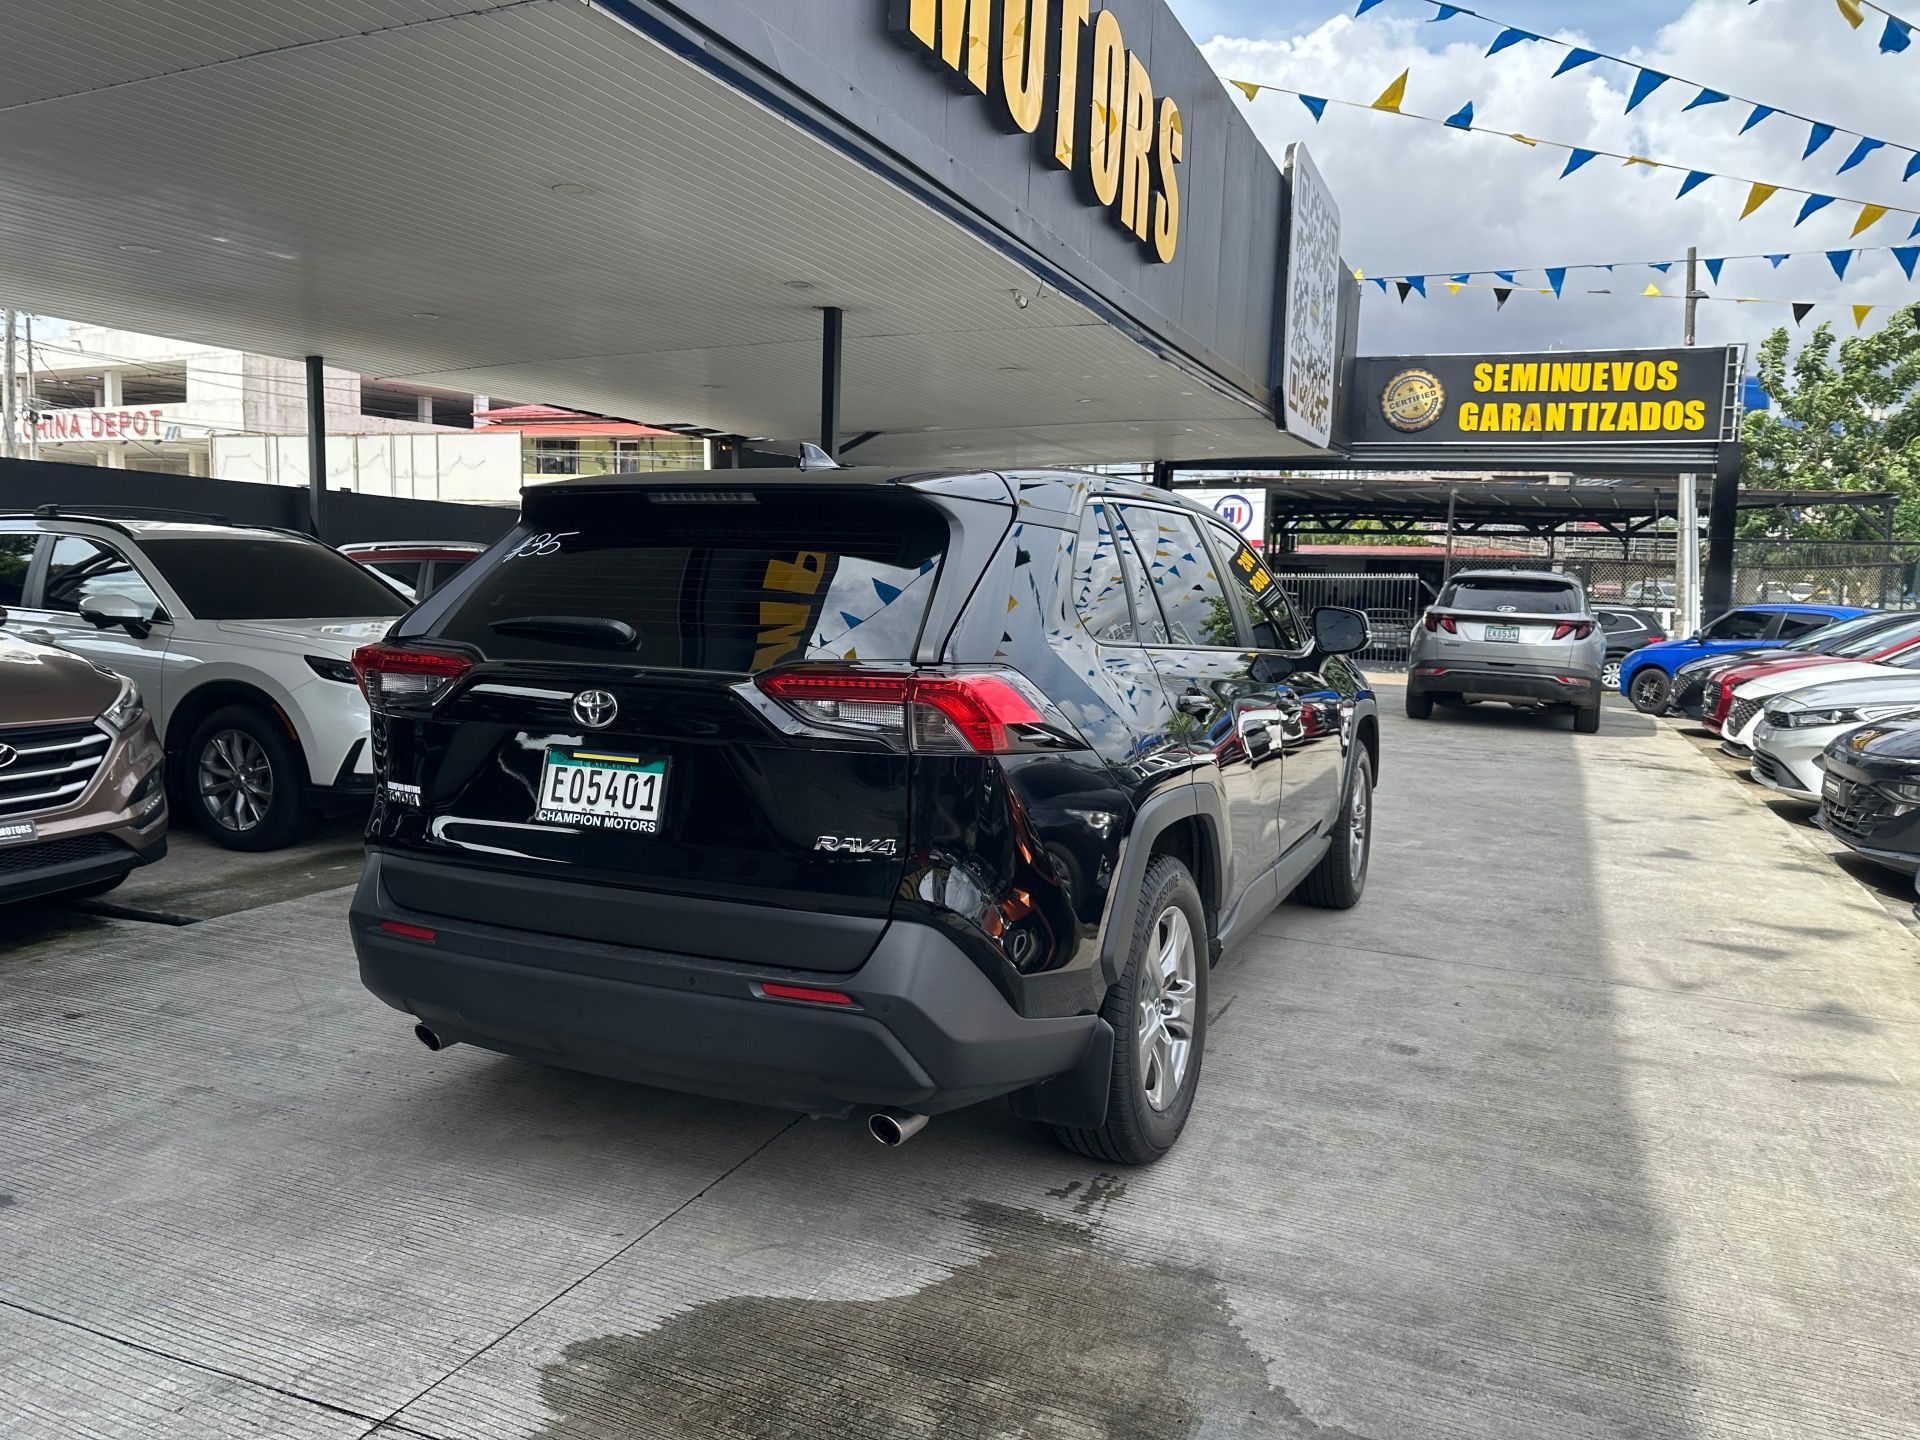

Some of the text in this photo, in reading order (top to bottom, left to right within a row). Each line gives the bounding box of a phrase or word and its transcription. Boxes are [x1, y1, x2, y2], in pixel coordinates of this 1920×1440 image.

[1473, 360, 1679, 393] SEMINUEVOS
[1389, 390, 1437, 410] CERTIFIED
[91, 409, 163, 438] DEPOT
[1458, 400, 1706, 432] GARANTIZADOS
[550, 766, 656, 812] E05401
[538, 810, 601, 827] CHAMPION
[604, 818, 656, 833] MOTORS
[814, 835, 897, 856] RAV4
